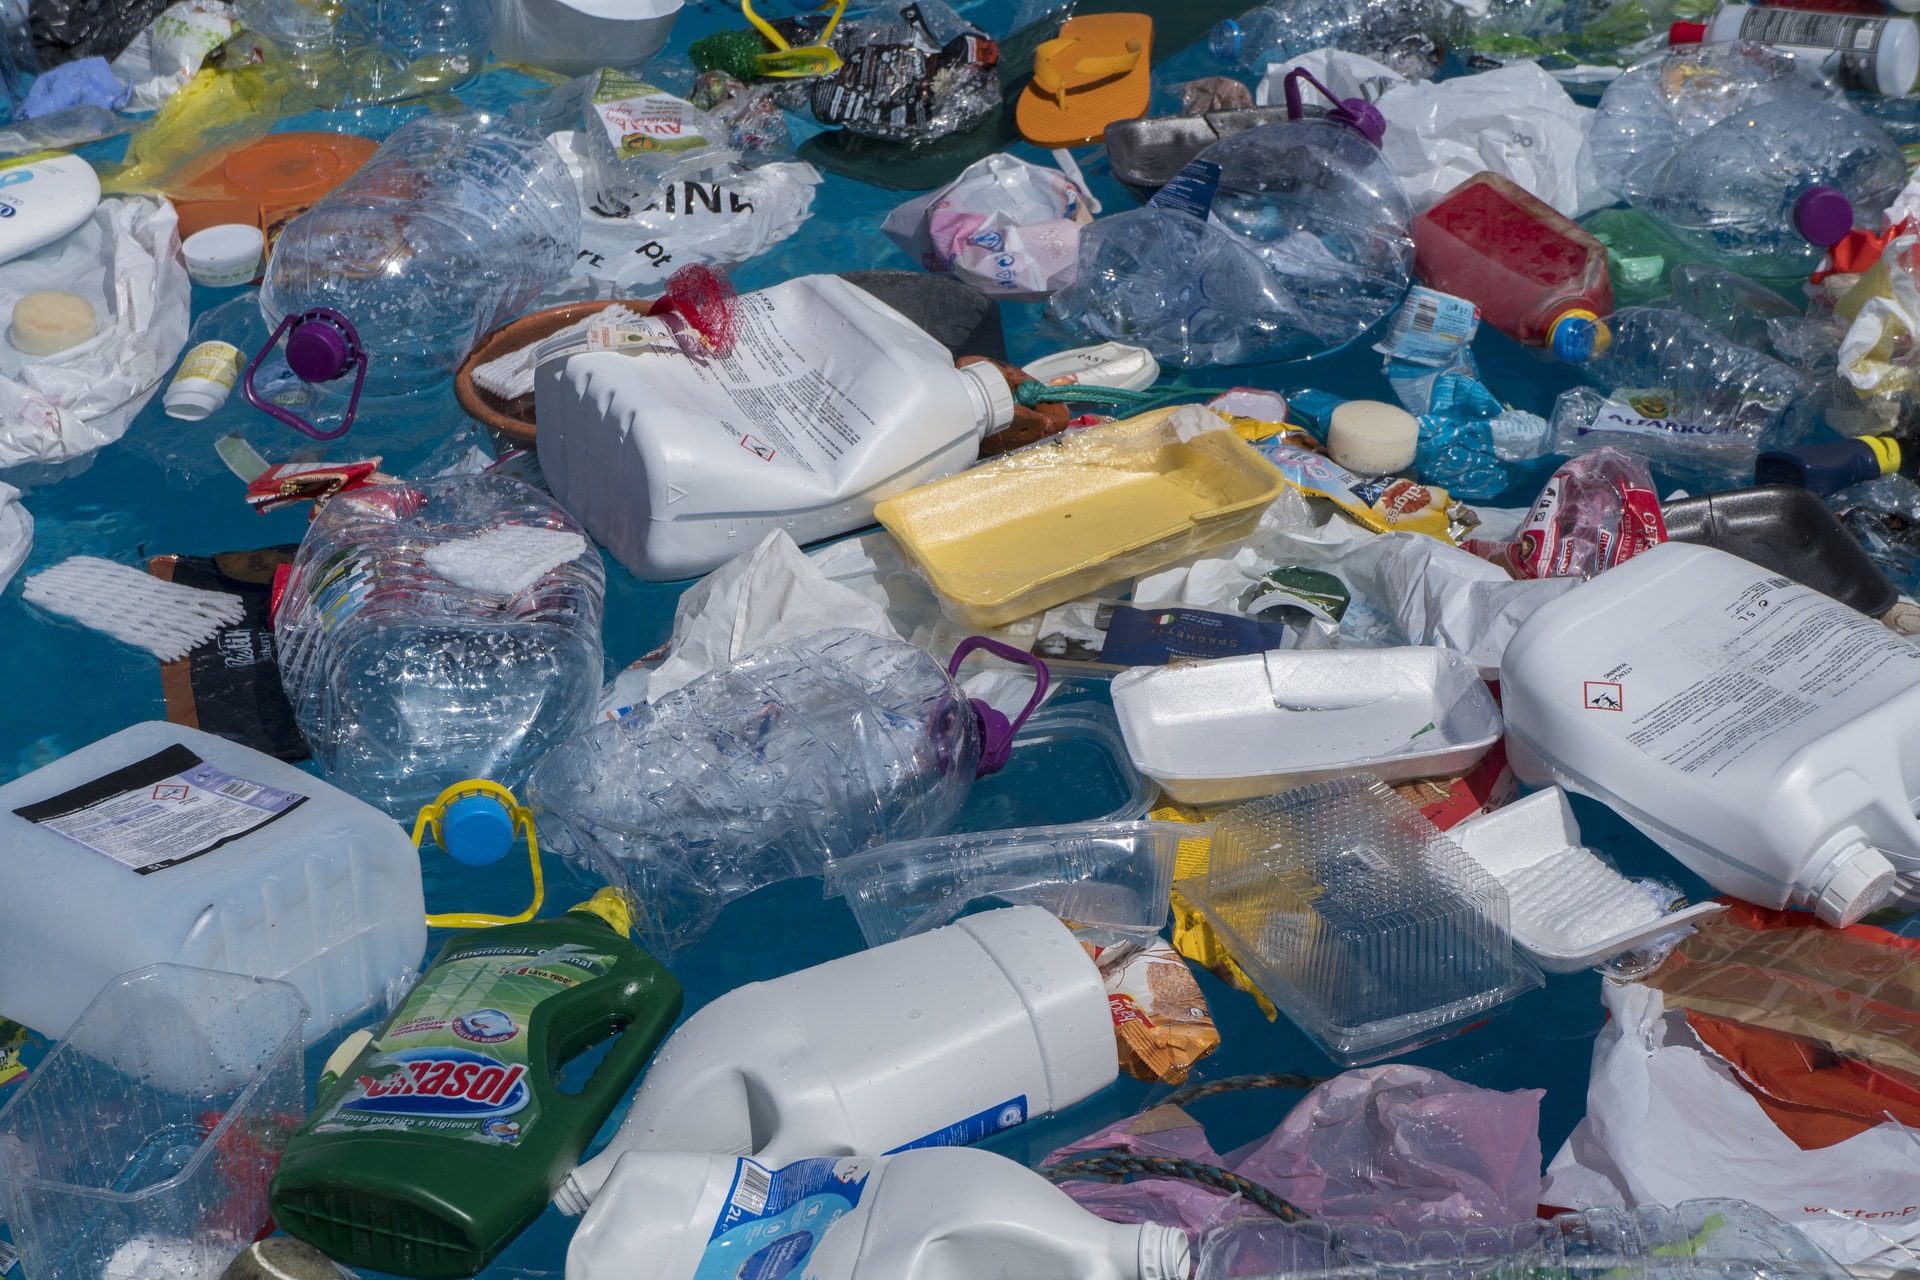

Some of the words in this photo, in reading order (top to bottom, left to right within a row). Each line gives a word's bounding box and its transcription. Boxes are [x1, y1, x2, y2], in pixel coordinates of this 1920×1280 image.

[635, 241, 673, 267] pt
[1608, 414, 1729, 434] ALFARRO
[1386, 484, 1427, 524] digree
[1598, 531, 1611, 571] BIMBO
[446, 948, 529, 961] Amoniacal
[358, 1061, 524, 1104] nasol
[428, 1119, 480, 1130] higiene!
[725, 1204, 742, 1223] 2L
[1803, 1205, 1918, 1220] wrten.p
